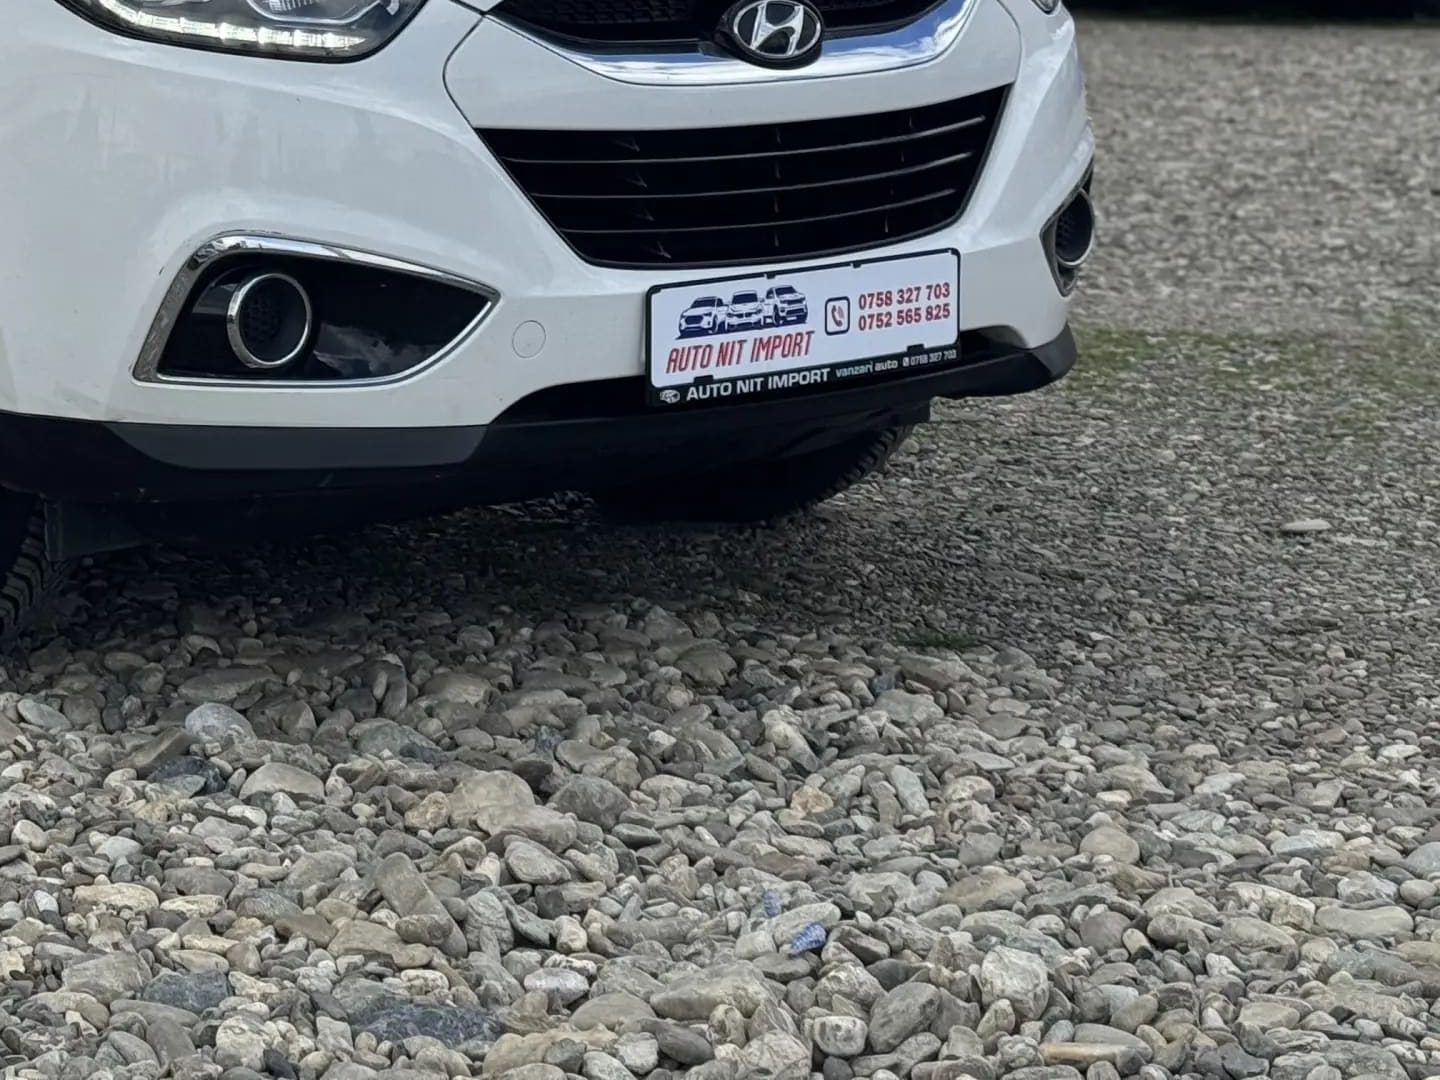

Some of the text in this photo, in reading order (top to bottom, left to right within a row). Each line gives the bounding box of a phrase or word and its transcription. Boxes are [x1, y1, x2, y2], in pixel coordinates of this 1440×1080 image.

[858, 282, 950, 311] 0758 327 703
[858, 302, 950, 331] 0752 565 825
[666, 330, 816, 374] AUTO NIT IMPORT
[686, 381, 732, 401] AUTO
[736, 377, 763, 394] NIT
[767, 368, 832, 389] IMPORT
[874, 358, 898, 372] auto
